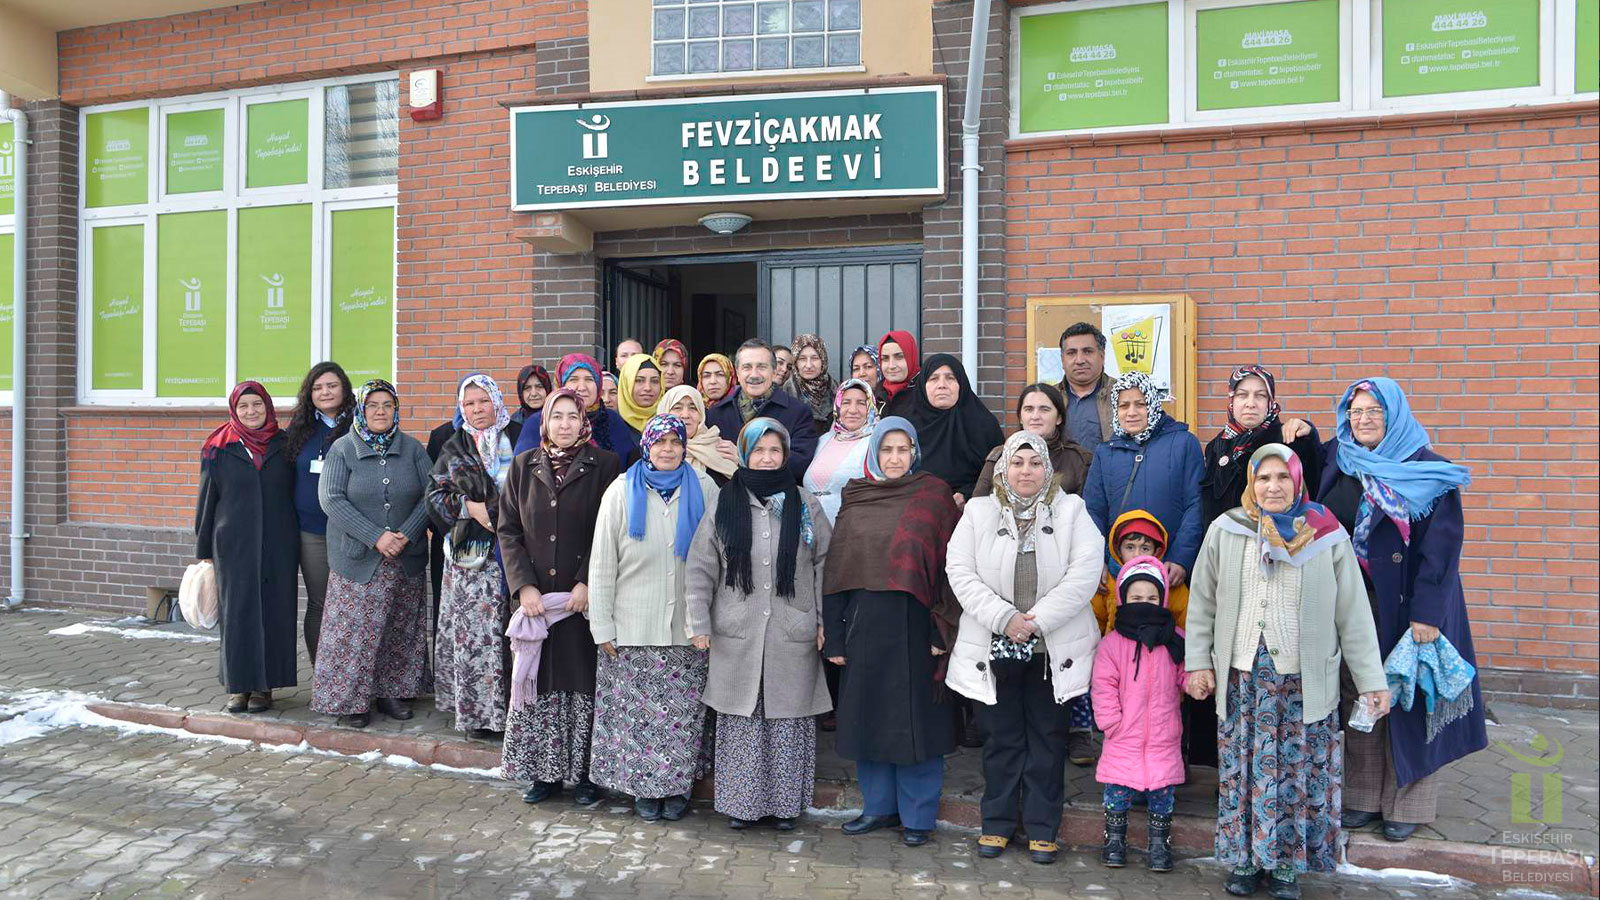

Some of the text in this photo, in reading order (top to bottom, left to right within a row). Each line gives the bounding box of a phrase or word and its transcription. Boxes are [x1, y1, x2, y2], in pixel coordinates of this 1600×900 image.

[1433, 18, 1485, 30] 444 44 26
[1264, 37, 1275, 45] 44
[1278, 36, 1290, 44] 26
[1071, 50, 1115, 60] 444 44 26
[681, 111, 883, 152] FEVZİÇAKMAK
[567, 163, 623, 177] ESKİŞEHİR
[536, 184, 588, 195] TEPEBAŞI
